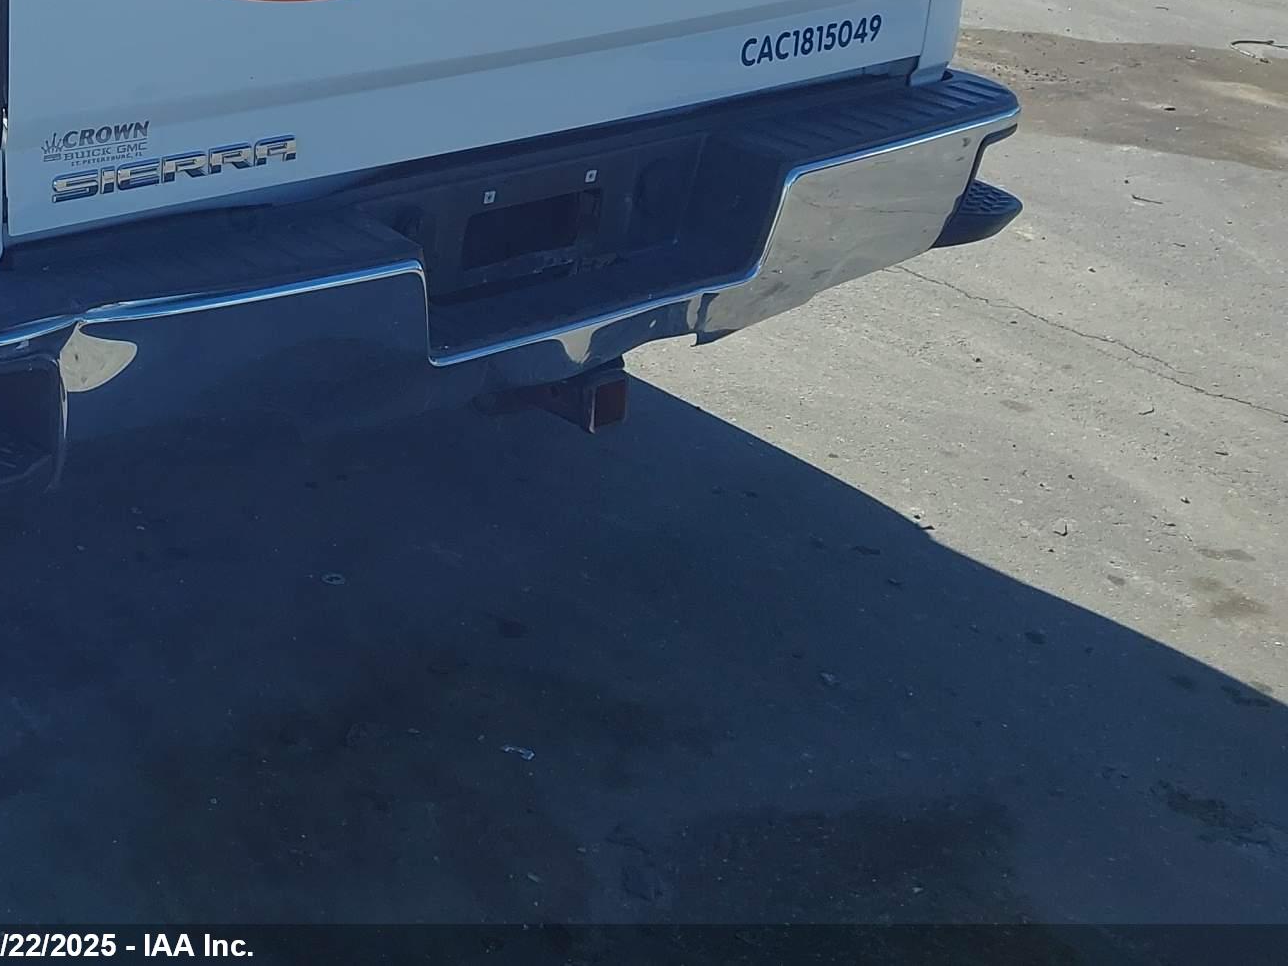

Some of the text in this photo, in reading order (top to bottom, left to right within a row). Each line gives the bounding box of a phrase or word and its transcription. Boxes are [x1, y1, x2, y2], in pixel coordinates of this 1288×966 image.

[741, 14, 882, 66] CAC1815049
[62, 120, 149, 148] CROWN
[64, 142, 147, 161] BUICK GMC
[52, 134, 296, 203] SIERRA
